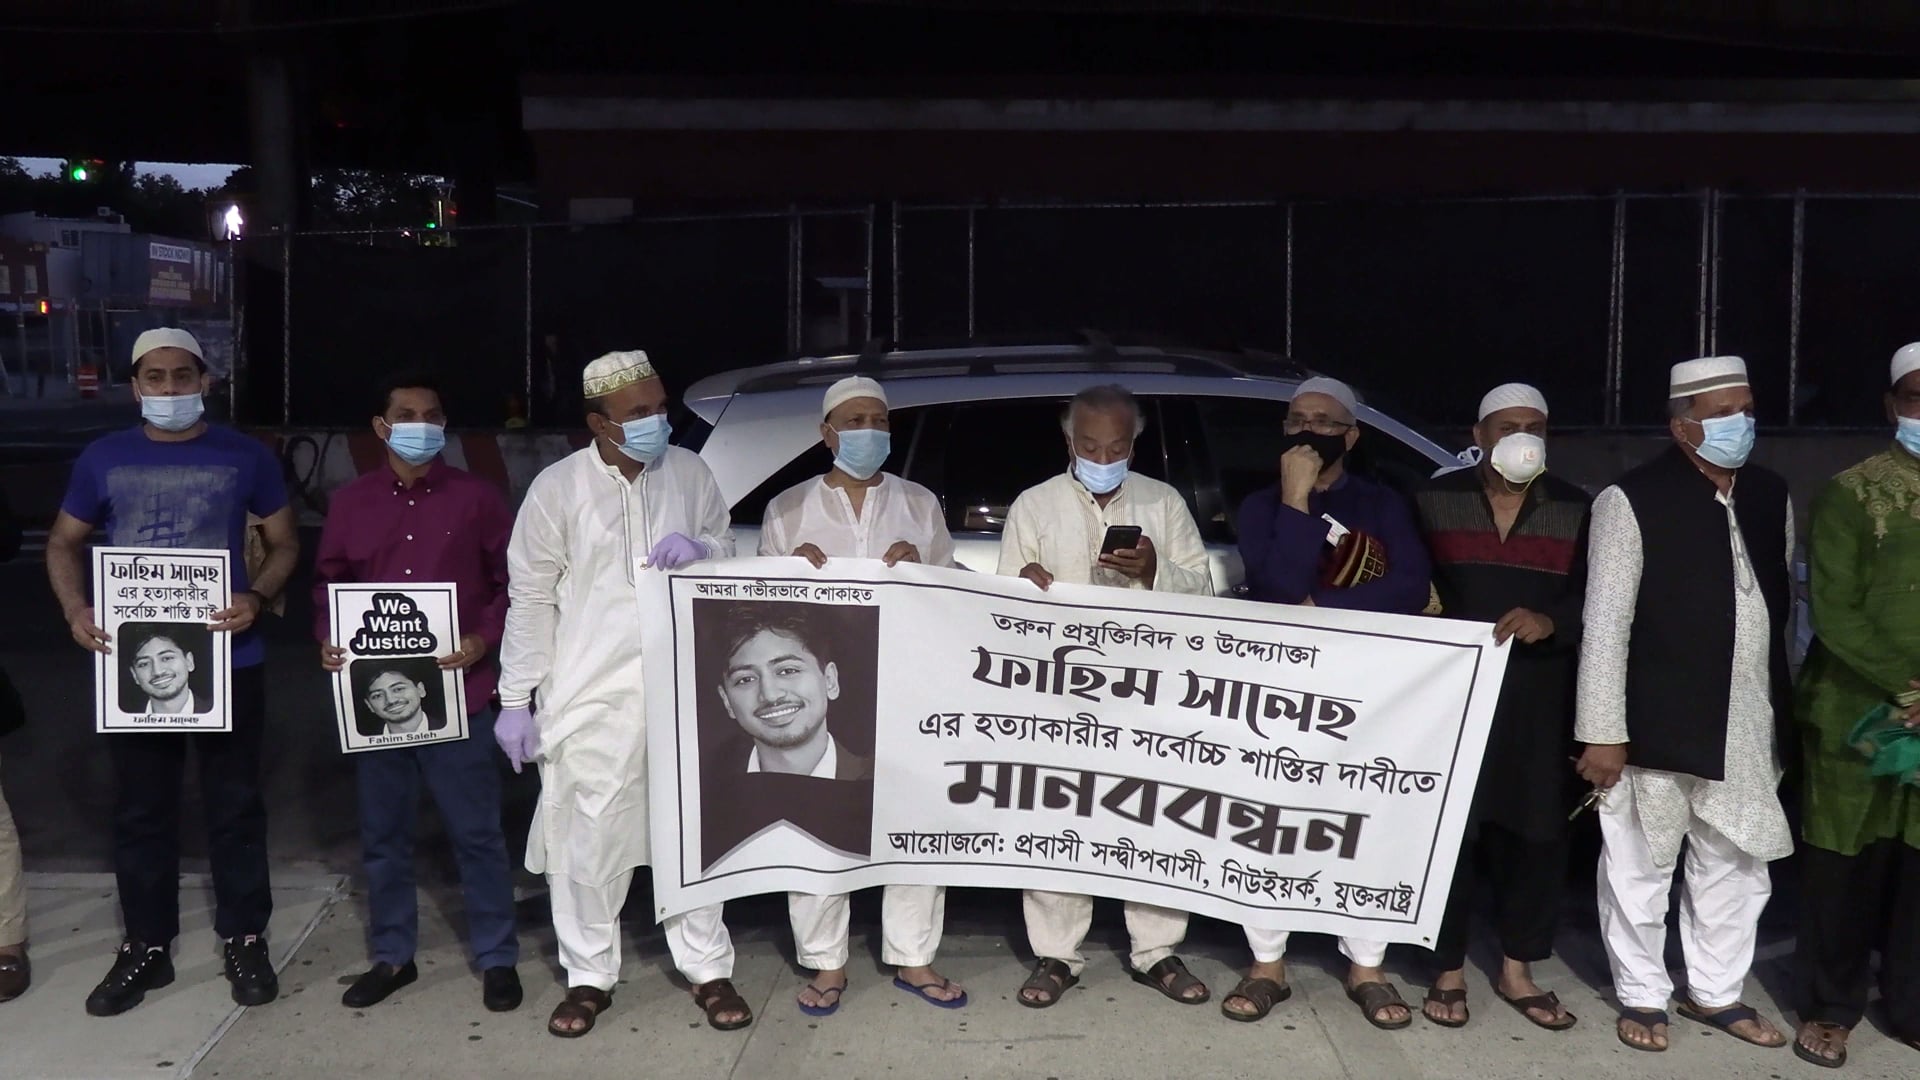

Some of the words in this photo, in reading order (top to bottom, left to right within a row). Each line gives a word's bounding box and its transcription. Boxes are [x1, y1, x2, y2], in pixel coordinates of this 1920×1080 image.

[110, 556, 165, 581] ফাহিম
[170, 562, 219, 585] সালেহ
[117, 586, 139, 600] এর
[143, 584, 209, 601] হত্যাকারীর
[695, 582, 738, 597] আমরা
[742, 580, 809, 599] গভীরভাবে
[814, 585, 875, 604] শোকাহত
[113, 601, 158, 619] সর্বোচ্চ
[378, 599, 411, 615] We
[369, 616, 422, 633] Want
[990, 612, 1056, 640] তরুন
[1062, 620, 1177, 650] প্রযুক্তিবিদ
[1185, 634, 1205, 651] ও
[356, 634, 431, 650] Justice
[970, 644, 1164, 706] ফাহিম
[1178, 668, 1363, 742] সালেহ
[368, 735, 403, 745] Fahim
[406, 731, 437, 741] Saleh
[919, 712, 965, 739] এর
[972, 712, 1123, 751] হত্যাকারীর
[1130, 730, 1231, 767] সর্বোচ্চ
[1238, 746, 1329, 786] শাস্তির
[1336, 756, 1443, 795] দাবীতে
[943, 760, 1371, 861] মানববন্ধন
[1014, 829, 1085, 863] প্রবাসী
[1333, 881, 1416, 917] যুক্তরাষ্ট্র
